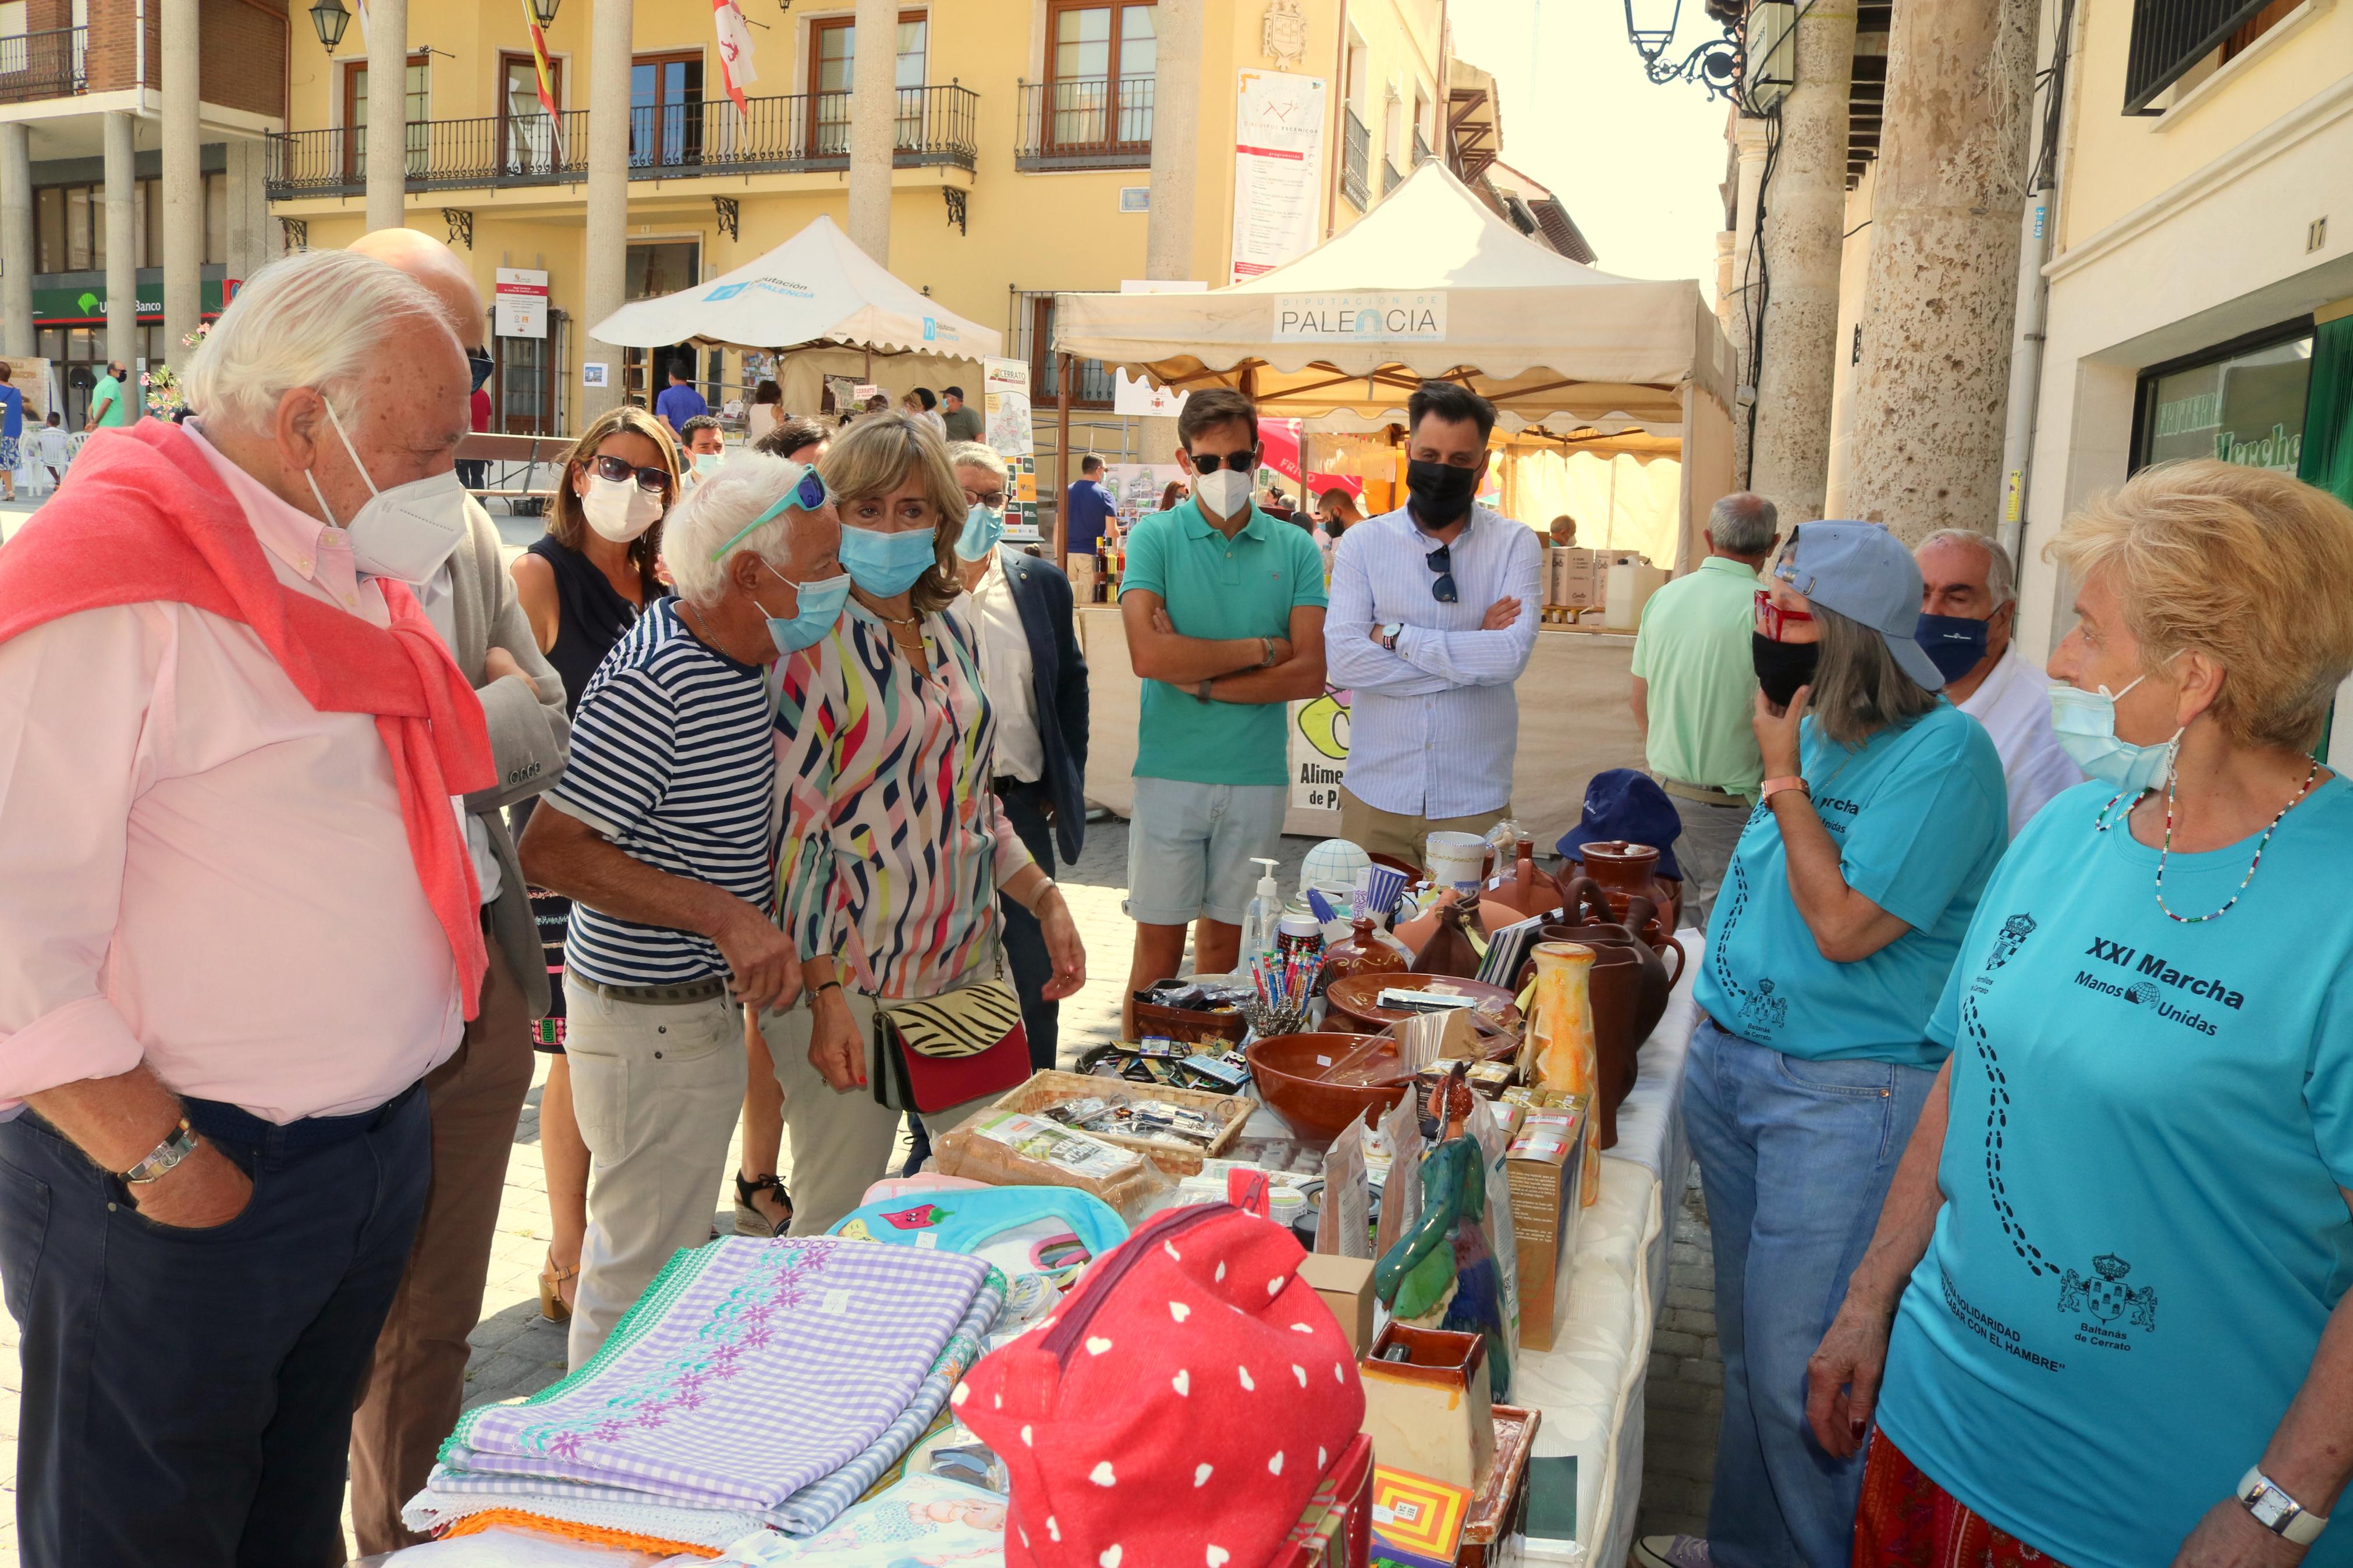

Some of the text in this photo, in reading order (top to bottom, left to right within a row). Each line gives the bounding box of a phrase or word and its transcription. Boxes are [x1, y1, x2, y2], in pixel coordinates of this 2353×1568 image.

[2308, 218, 2326, 251] 17
[757, 282, 814, 298] PALENCIA
[136, 300, 161, 312] Banco
[1283, 296, 1438, 307] DIPUTACIÓN DE
[1000, 369, 1026, 381] CERRATO
[2214, 423, 2301, 467] Merche
[1300, 763, 1344, 784] Alime
[1309, 789, 1341, 811] de P
[1819, 797, 1859, 816] rcha
[2085, 937, 2136, 967] XXI
[2074, 970, 2123, 998] Manos
[2135, 953, 2245, 1010] Marcha
[1747, 1022, 1770, 1033] Baltanás
[2156, 1001, 2218, 1036] Unidas
[1751, 1032, 1772, 1041] Cerrato
[1957, 1295, 2021, 1342] SOLIDARIDAD
[1968, 1318, 1987, 1339] CON
[1989, 1333, 2003, 1348] EL
[2081, 1322, 2127, 1341] Baltanás
[2074, 1333, 2131, 1352] de Cerrato
